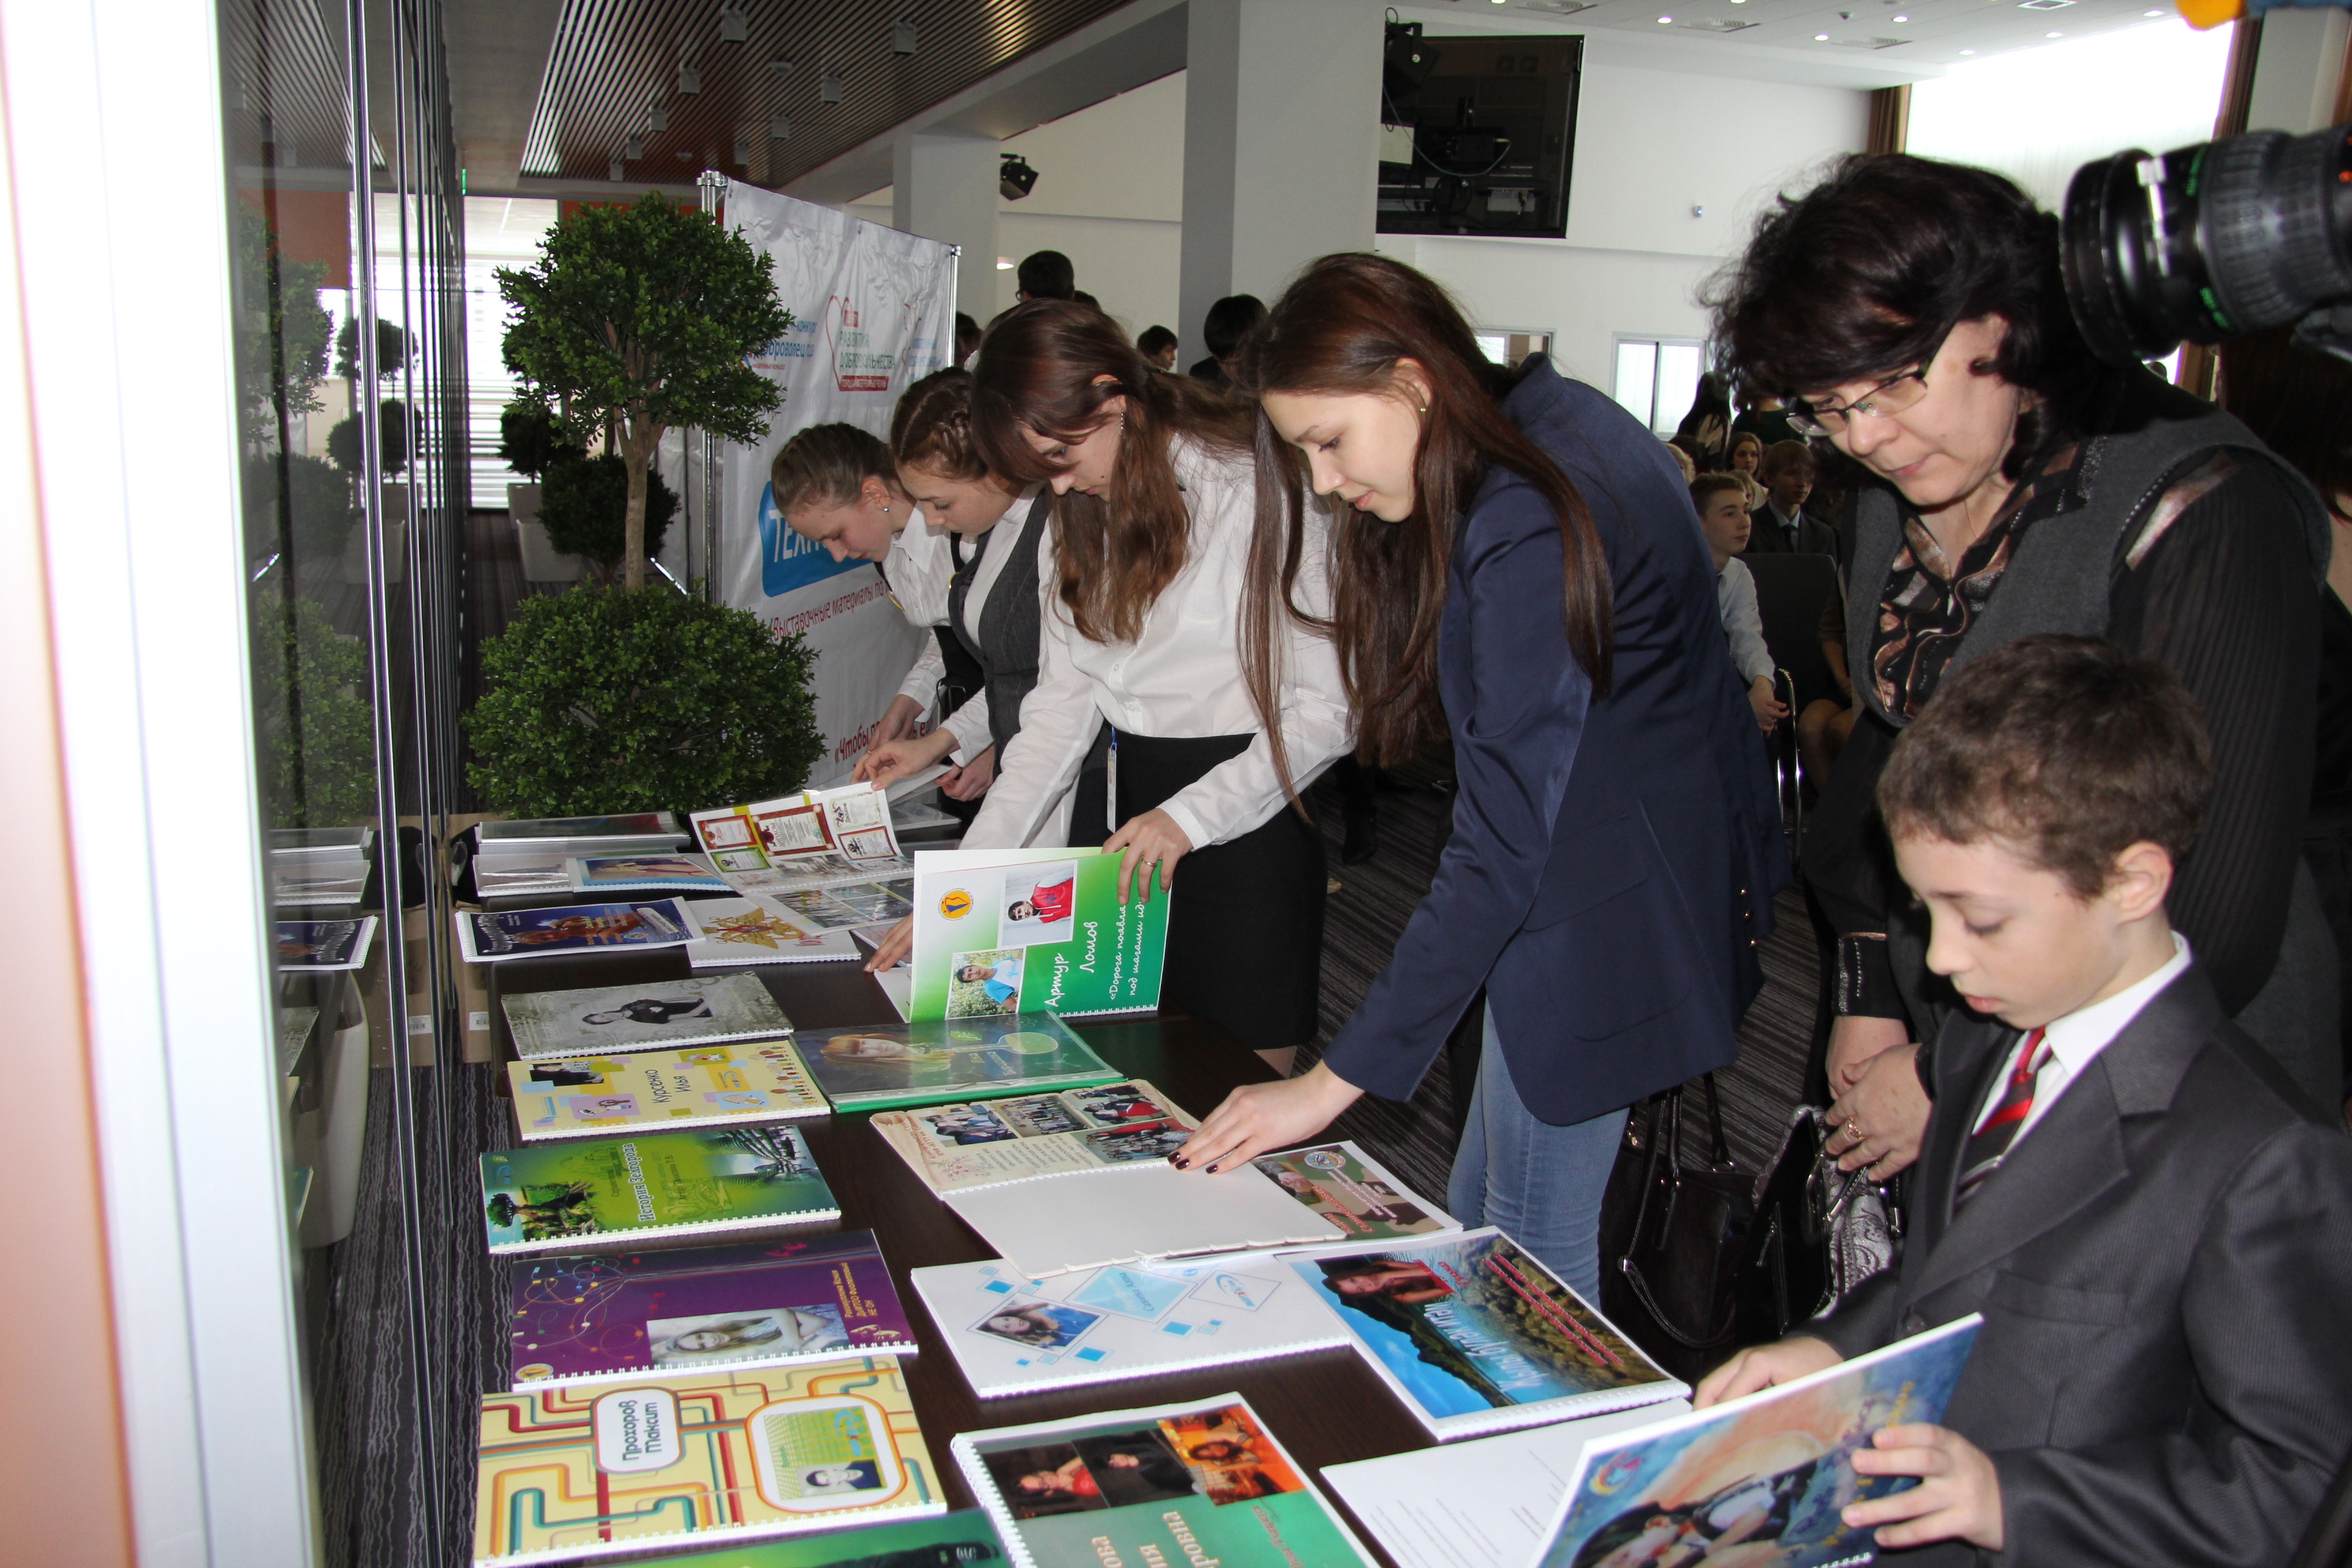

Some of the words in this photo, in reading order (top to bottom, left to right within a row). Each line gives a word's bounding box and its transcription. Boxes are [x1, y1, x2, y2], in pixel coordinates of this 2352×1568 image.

[832, 587, 875, 617] материалы
[1115, 904, 1126, 949] появля
[1135, 898, 1145, 918] ид
[1079, 921, 1098, 973] Ломов
[1132, 920, 1144, 974] шагами
[1044, 953, 1069, 1007] Артур
[1109, 951, 1122, 1000] «Дорога
[1128, 978, 1139, 996] под
[644, 1068, 672, 1104] Курсенко
[673, 1075, 693, 1093] Илья
[622, 1143, 644, 1183] Зелгорода
[634, 1184, 656, 1222] История
[1311, 1185, 1374, 1232] Станиславович
[620, 1399, 642, 1463] Прохоров
[644, 1401, 661, 1454] Максим
